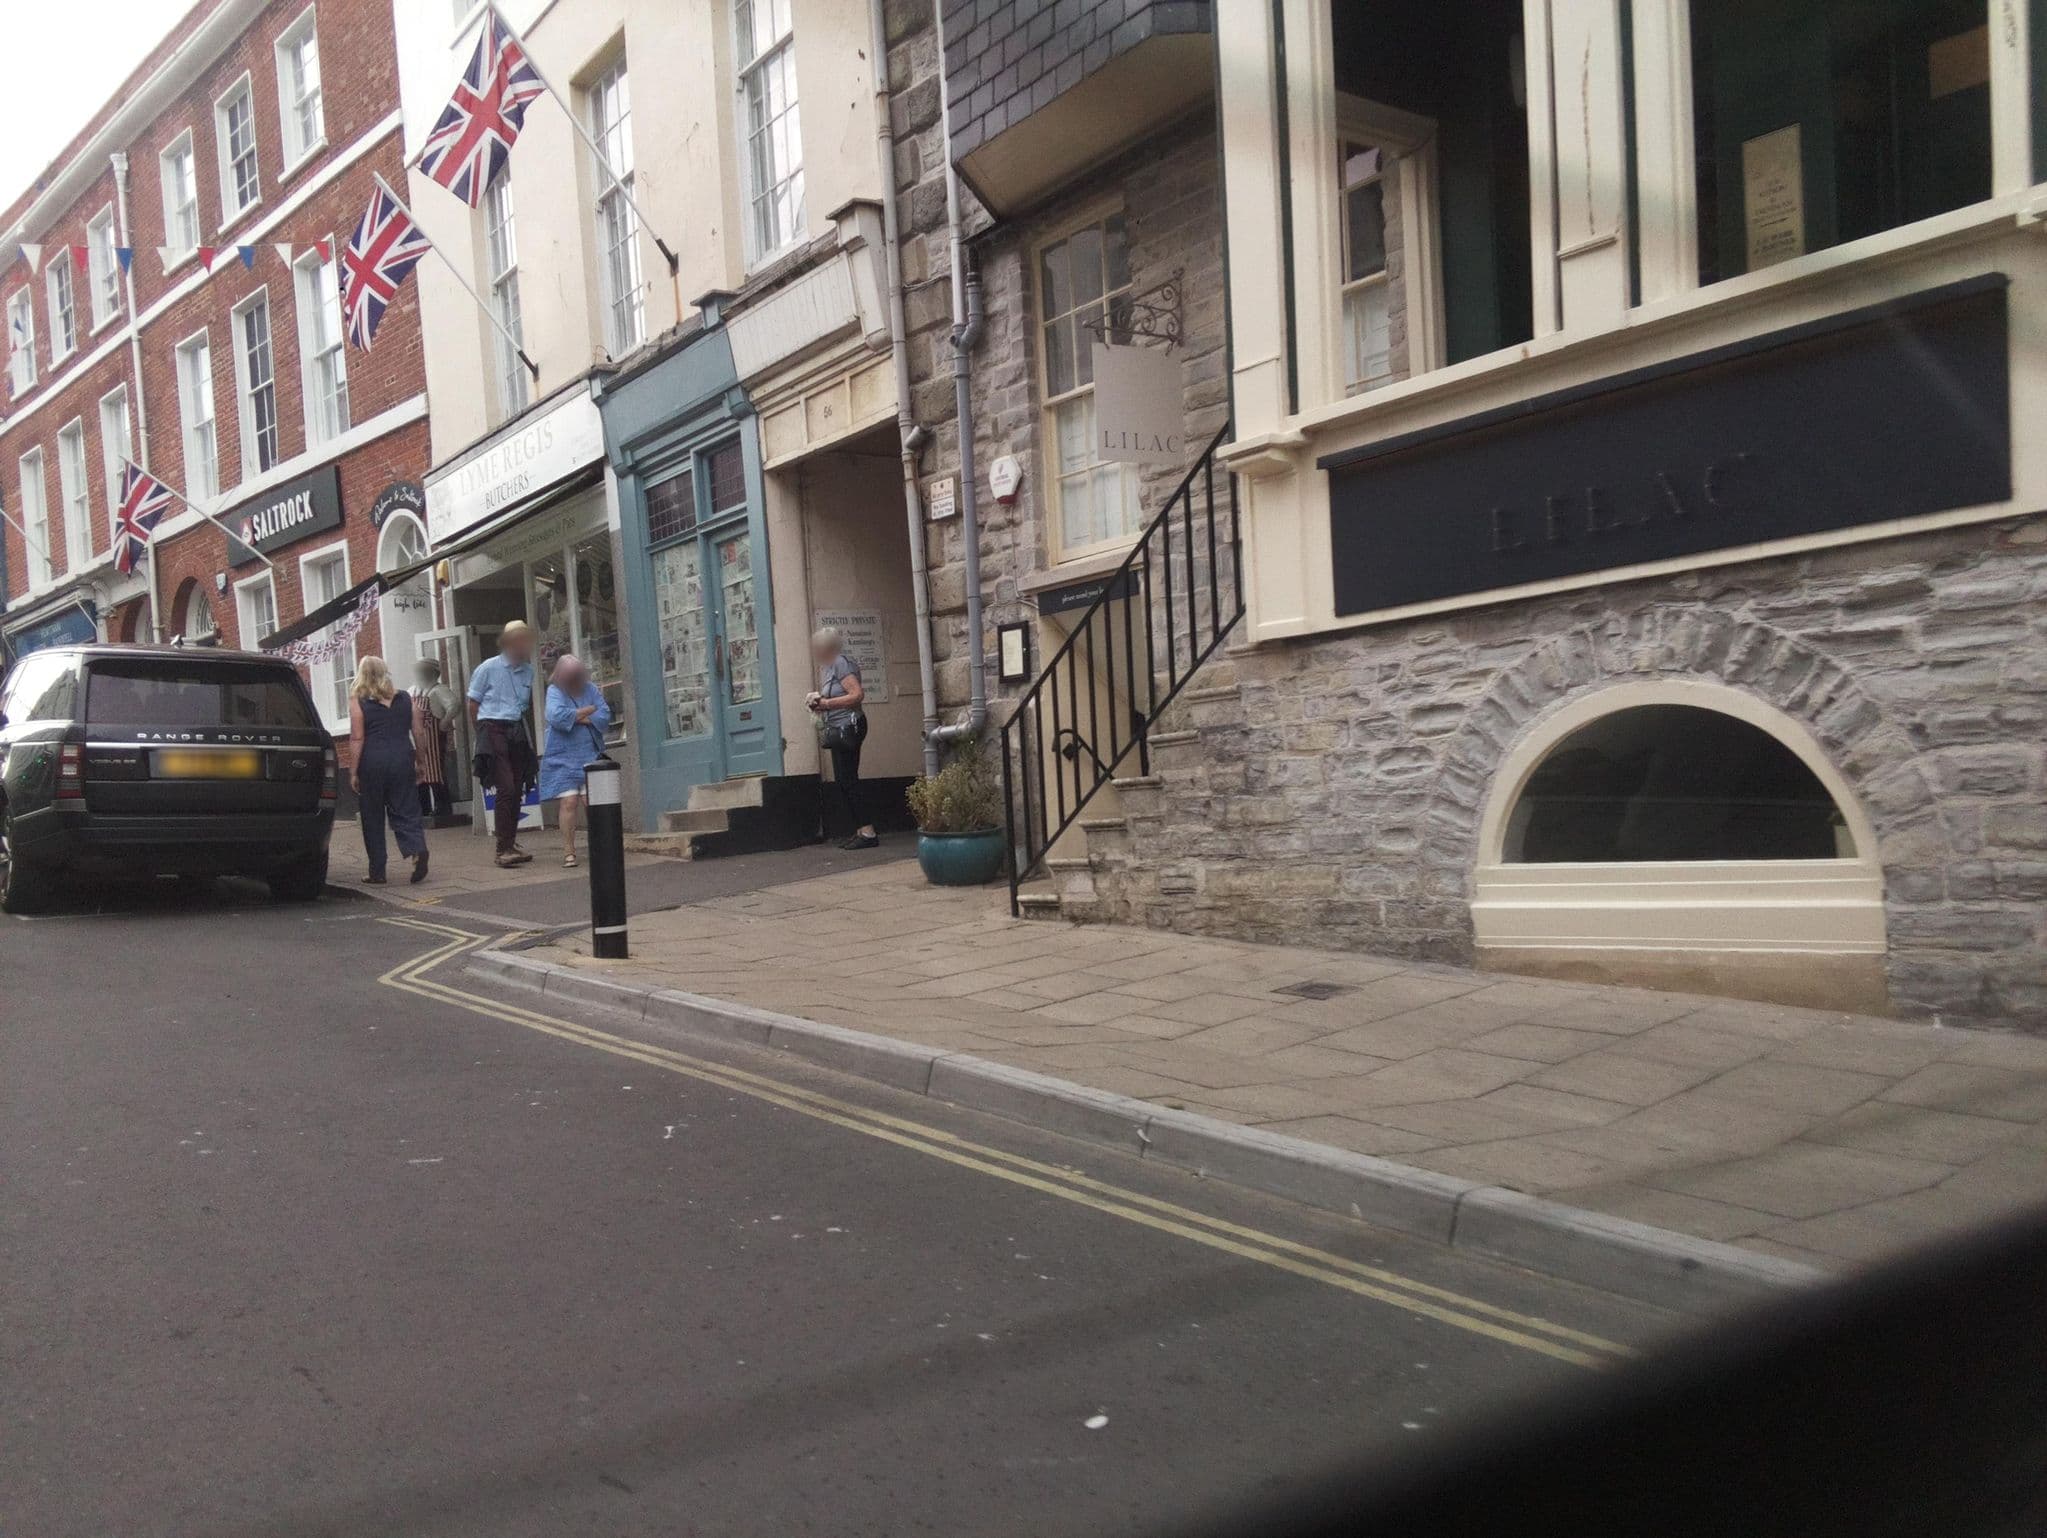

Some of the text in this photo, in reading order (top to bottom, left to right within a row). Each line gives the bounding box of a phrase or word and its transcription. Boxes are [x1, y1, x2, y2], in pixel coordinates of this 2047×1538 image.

[459, 421, 554, 496] LYME REGIS
[1104, 430, 1179, 453] LILAC
[485, 471, 530, 510] BUTCHERS
[1488, 451, 1747, 551] LILAC
[252, 490, 314, 542] SALTROCK
[136, 732, 281, 742] RANGE ROVER
